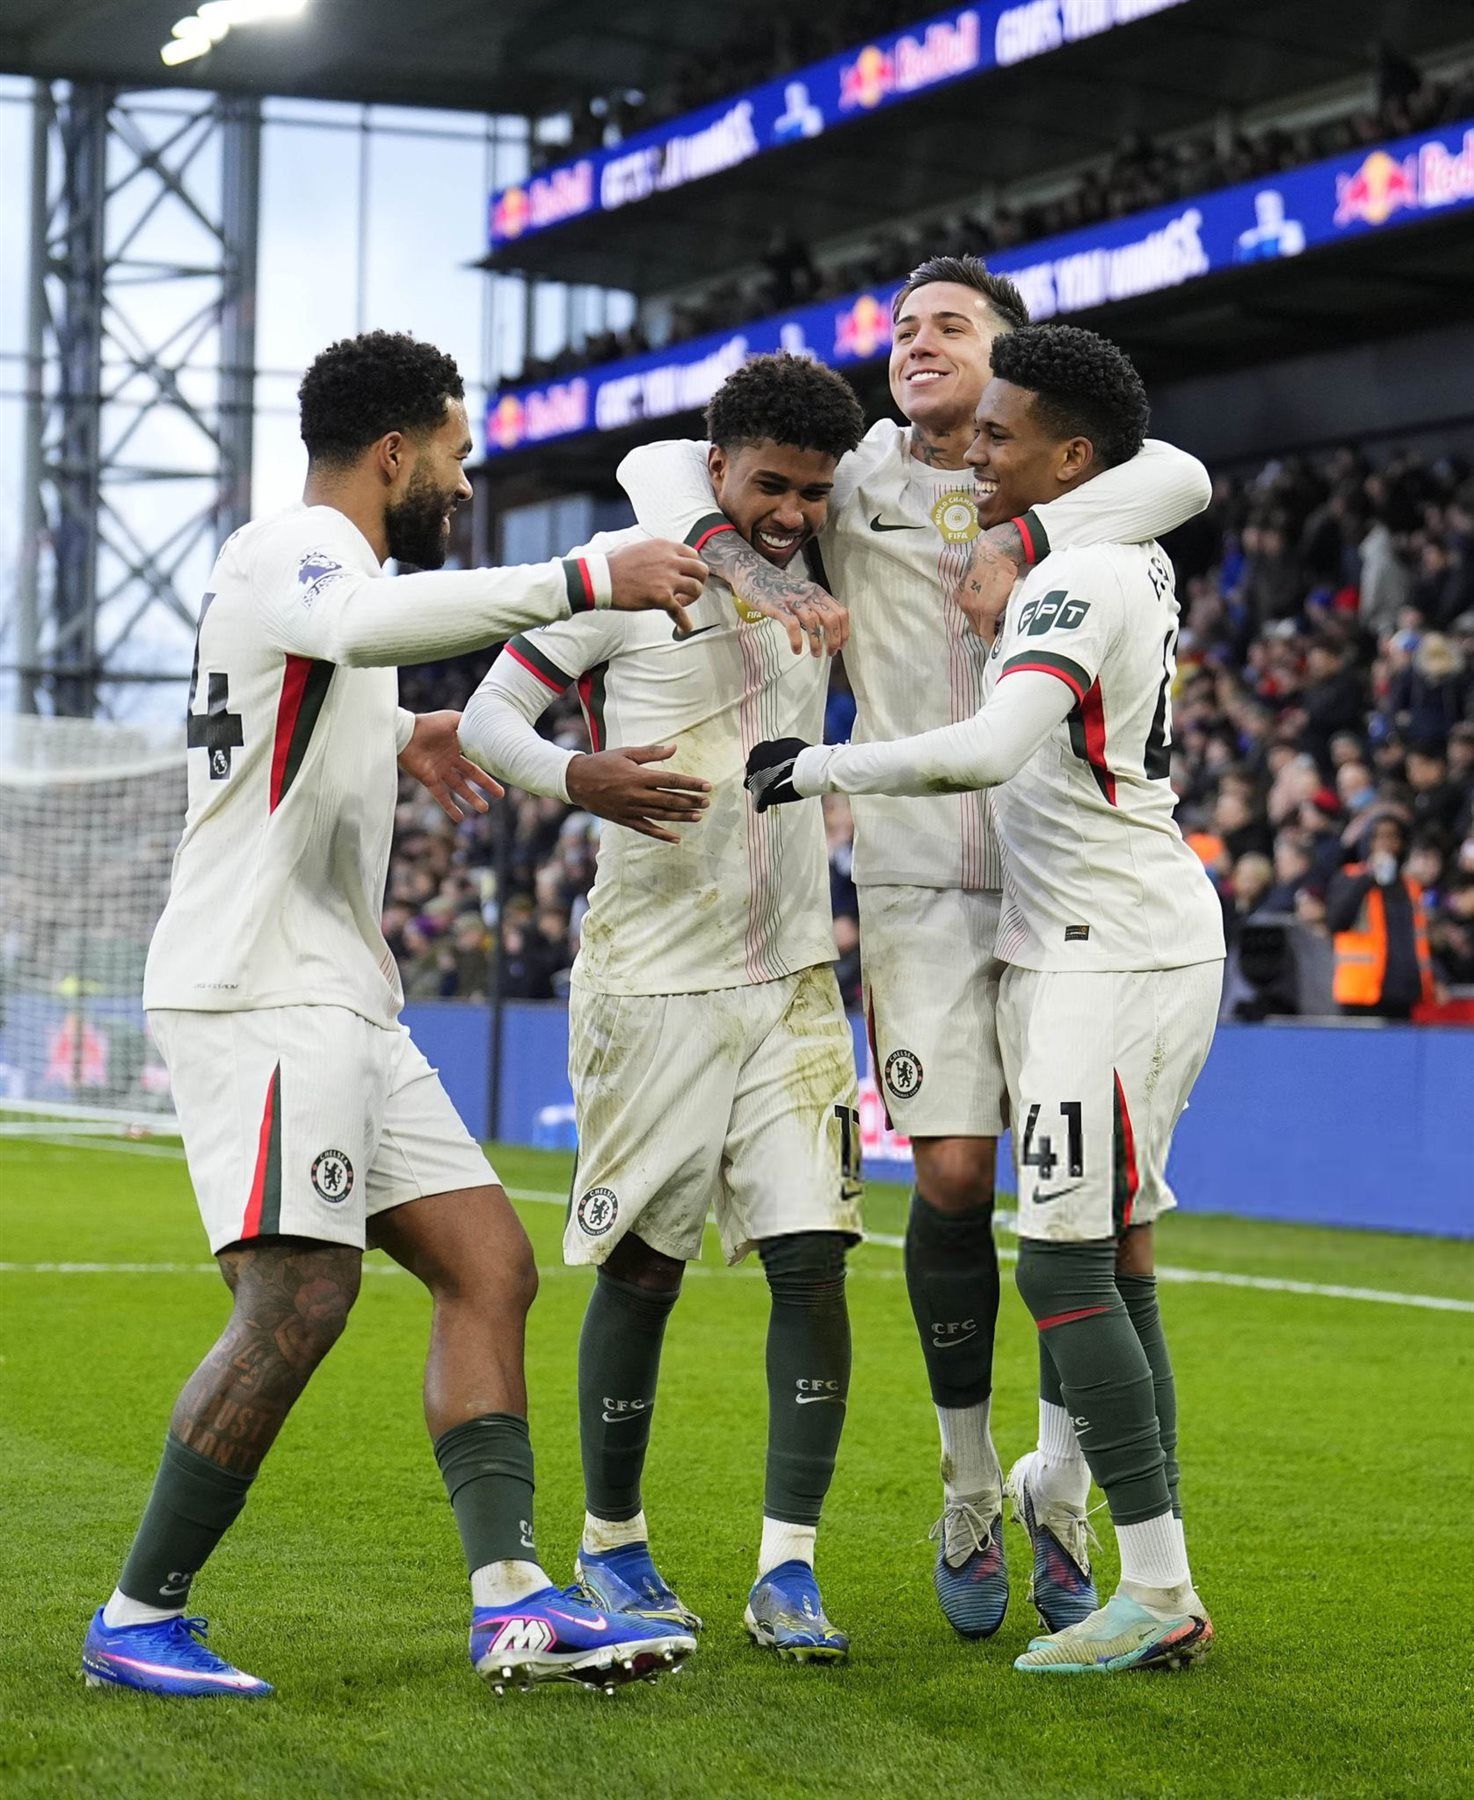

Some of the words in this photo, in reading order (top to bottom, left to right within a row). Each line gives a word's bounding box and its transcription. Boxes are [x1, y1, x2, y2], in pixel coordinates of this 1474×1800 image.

[747, 611, 762, 619] FIFA
[1018, 600, 1086, 631] FPT
[889, 1050, 915, 1063] CHELSEA
[1023, 1101, 1083, 1180] 41
[320, 1151, 348, 1166] CHELSEA
[589, 1188, 616, 1203] CHELSEA
[932, 1318, 977, 1334] CFC
[795, 1378, 839, 1391] CFC
[602, 1396, 645, 1411] CFC
